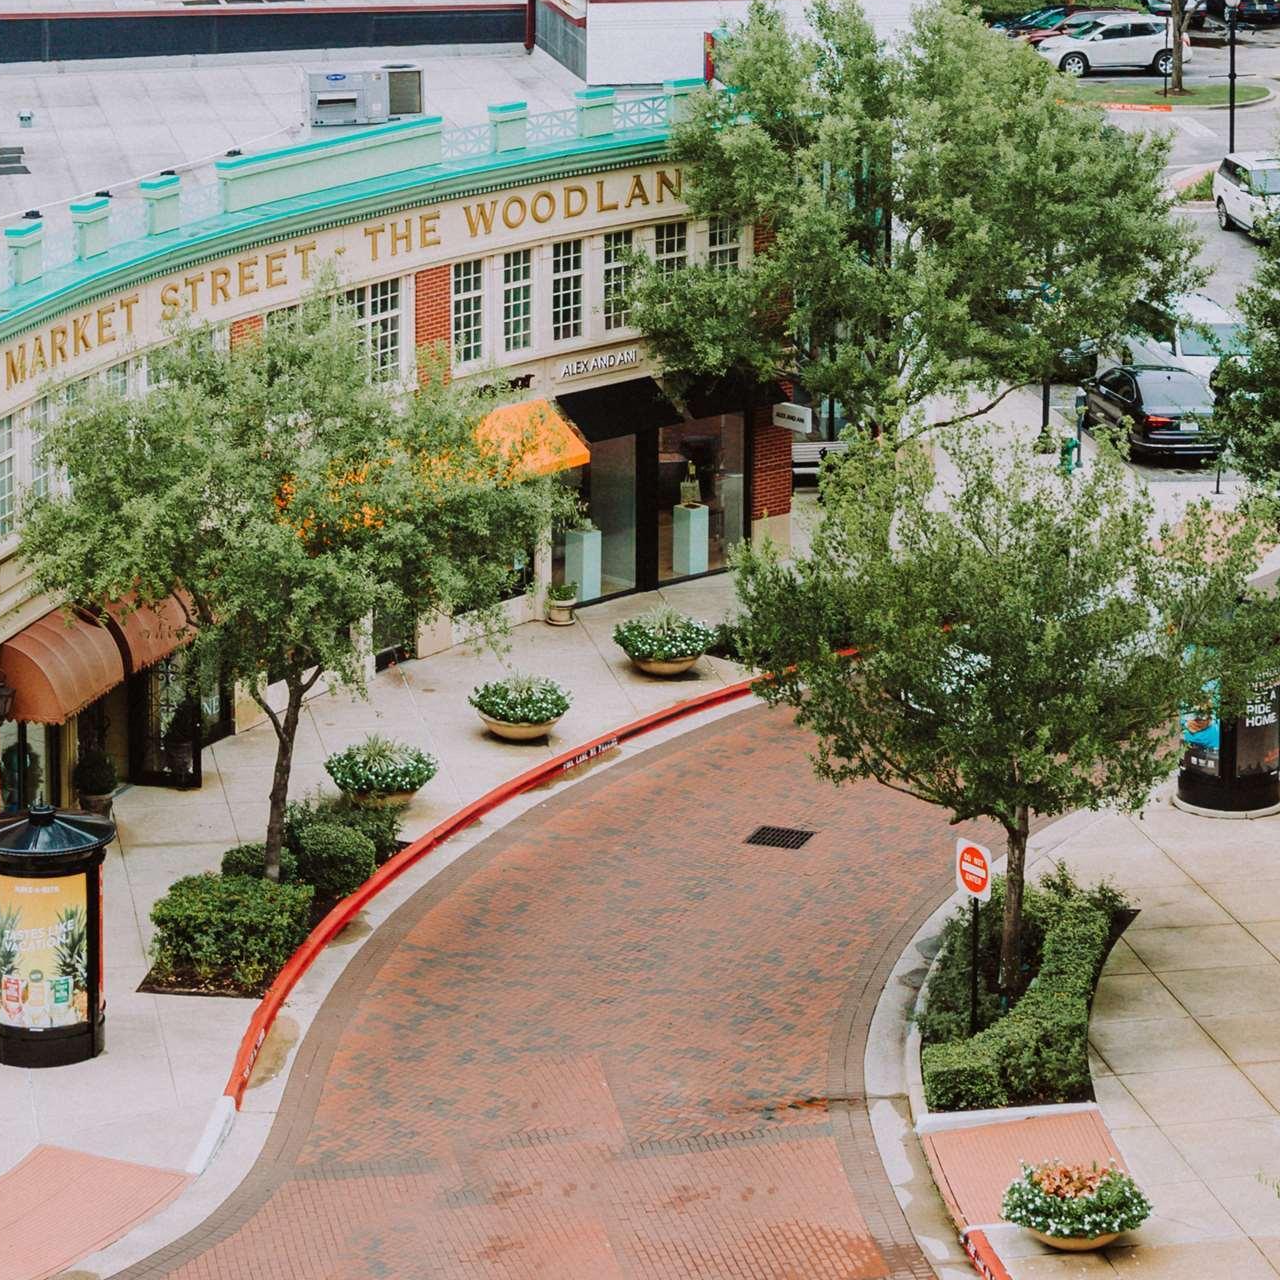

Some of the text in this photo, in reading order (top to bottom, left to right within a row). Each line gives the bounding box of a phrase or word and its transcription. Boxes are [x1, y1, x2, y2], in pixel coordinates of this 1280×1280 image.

[4, 168, 685, 391] MARKET STREET THE WOODLAN
[562, 349, 638, 378] ALEX AND ANI
[787, 414, 796, 422] AND
[1245, 712, 1278, 728] HOME
[963, 852, 984, 868] DO NOT
[965, 873, 982, 887] ENTER
[3, 918, 75, 942] TASTES LIKE
